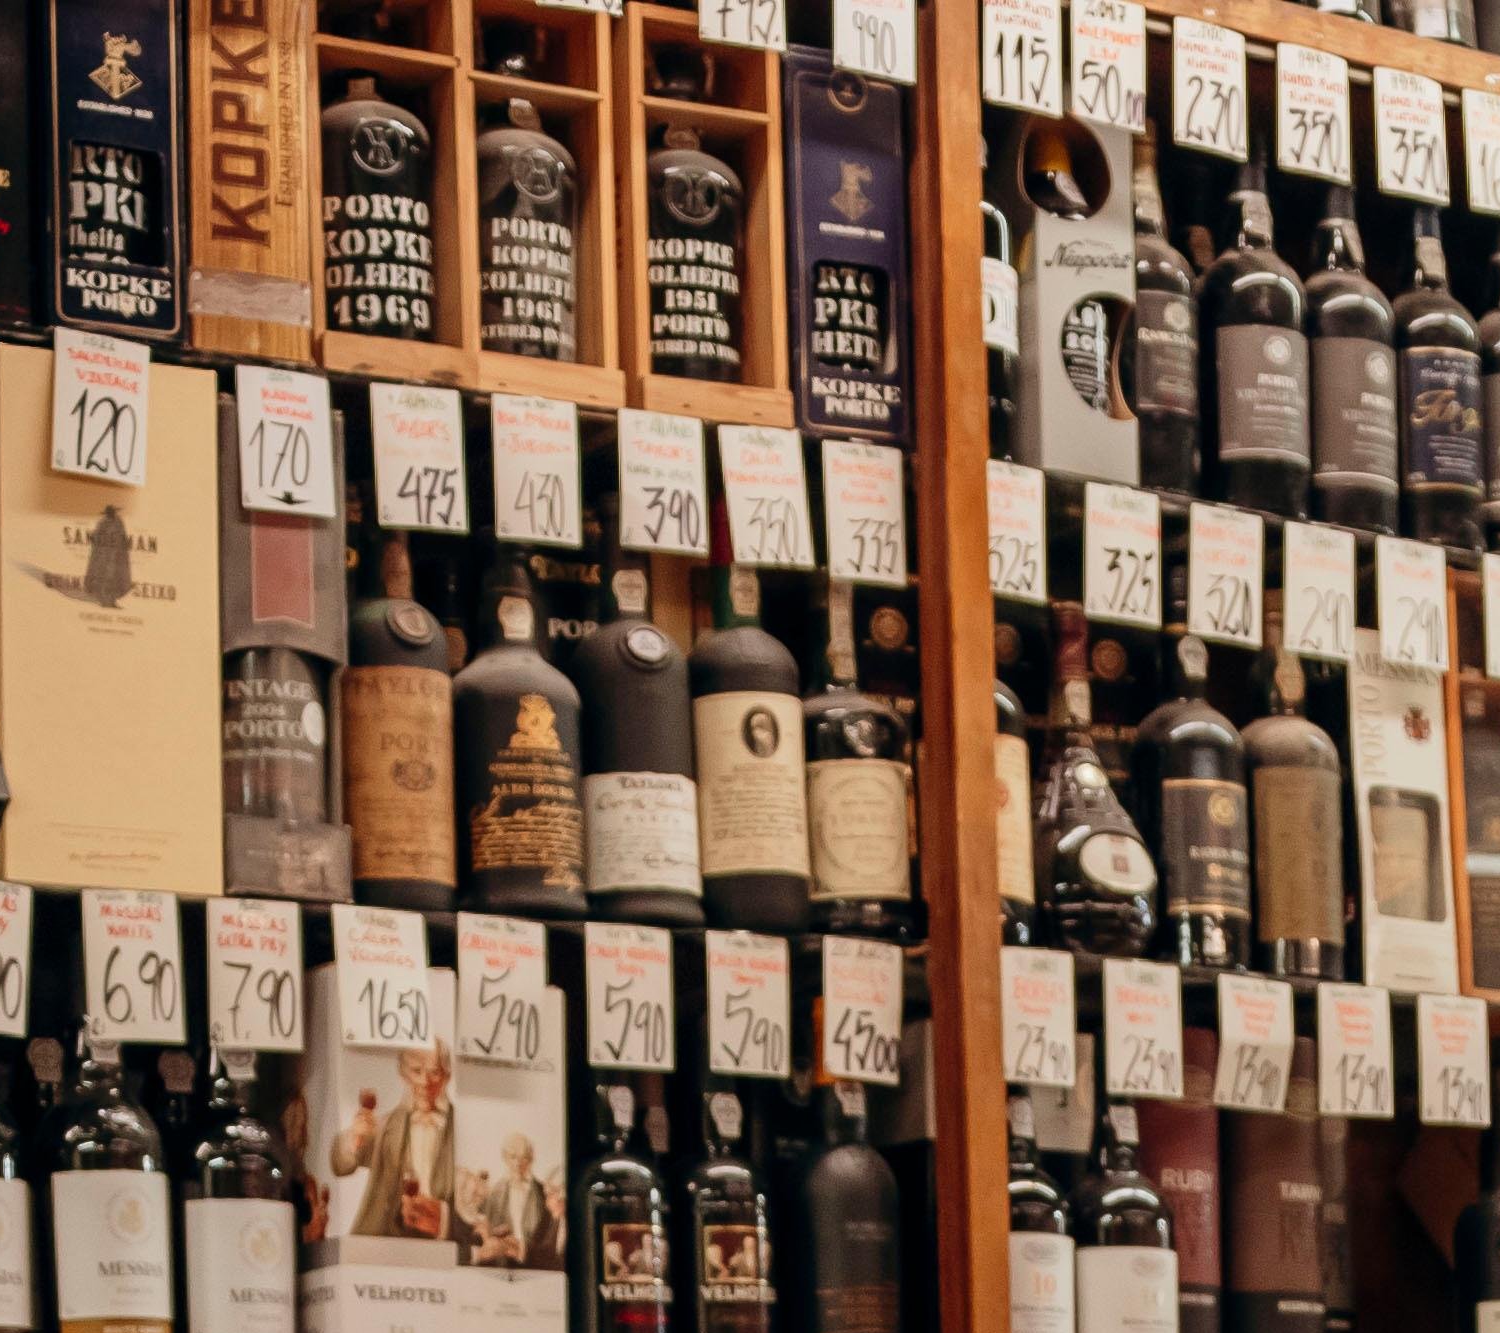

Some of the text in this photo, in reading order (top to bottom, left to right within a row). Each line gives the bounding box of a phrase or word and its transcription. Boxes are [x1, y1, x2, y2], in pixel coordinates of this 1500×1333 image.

[65, 267, 173, 301] KOPKE
[333, 294, 431, 331] 1969
[810, 376, 902, 405] KOPKE
[354, 1282, 449, 1306] VELHOTES
